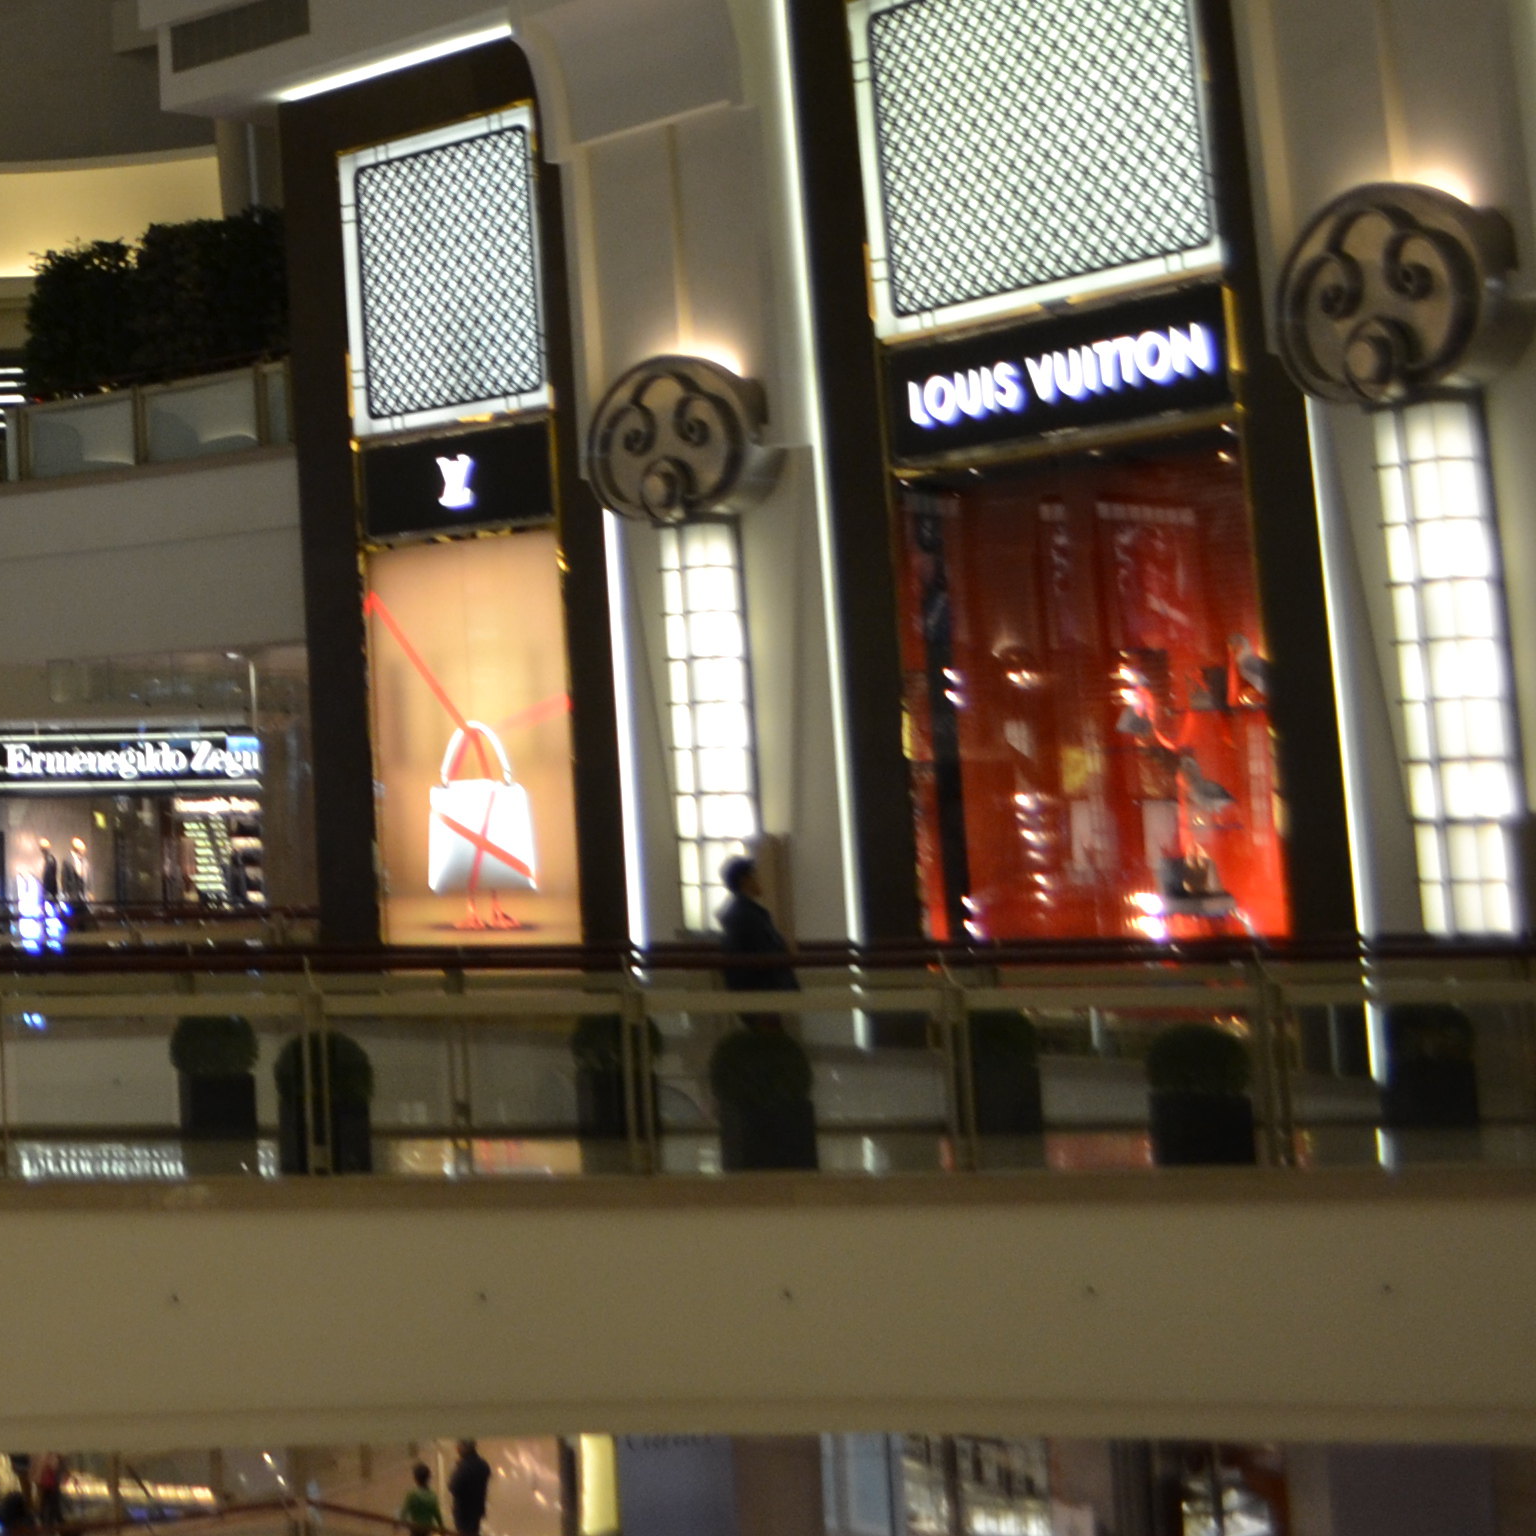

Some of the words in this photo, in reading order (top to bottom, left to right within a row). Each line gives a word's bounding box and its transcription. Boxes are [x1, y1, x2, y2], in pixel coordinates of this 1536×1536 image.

[907, 362, 1024, 428] LOUIS
[1025, 322, 1216, 404] VUITTON
[2, 740, 187, 779] Ermenegildo
[190, 740, 260, 777] Zegn
